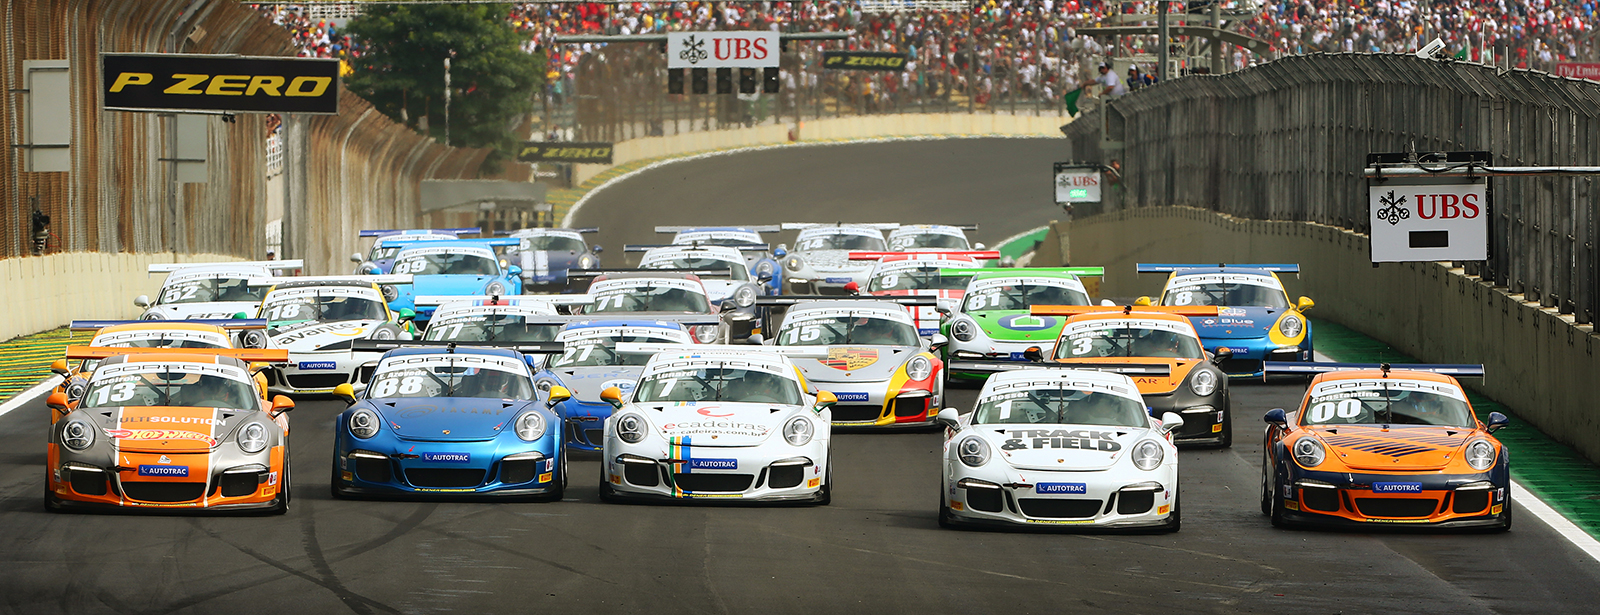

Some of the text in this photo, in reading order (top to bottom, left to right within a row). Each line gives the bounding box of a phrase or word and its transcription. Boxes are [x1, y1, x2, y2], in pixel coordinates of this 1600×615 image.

[713, 37, 768, 60] UBS
[1559, 65, 1600, 77] Fly Emir
[109, 71, 332, 98] P ZERO
[1072, 176, 1098, 187] UBS
[1415, 193, 1479, 221] UBS
[396, 260, 427, 275] 99
[595, 280, 695, 290] PORSCHE
[881, 275, 898, 289] 9
[976, 278, 1075, 288] PORSCHE
[1174, 276, 1274, 285] PORSCHE
[165, 286, 198, 303] 52
[273, 288, 374, 298] PORSCHE
[1174, 292, 1193, 306] 8
[596, 294, 624, 311] 71
[968, 293, 1001, 311] 81
[269, 304, 300, 321] 18
[792, 310, 903, 320] PORSCHE
[278, 321, 356, 345] avante
[563, 328, 681, 339] PORSCHE
[1072, 321, 1187, 332] PORSCHE
[99, 332, 219, 343] PORSCHE
[785, 325, 821, 344] 15
[1072, 338, 1093, 355] 3
[556, 344, 595, 367] 27
[388, 356, 518, 370] PORSCHE
[653, 361, 783, 374] PORSCHE
[103, 364, 239, 377] PORSCHE
[387, 370, 428, 379] Azevedo
[656, 370, 698, 379] Lunardi
[93, 383, 136, 405] 13
[374, 376, 424, 398] 88
[659, 378, 678, 398] 7
[993, 380, 1128, 394] PORSCHE
[1320, 381, 1454, 395] PORSCHE
[1312, 391, 1380, 404] Constantino
[994, 399, 1013, 420] 1
[1312, 399, 1362, 423] 00
[105, 415, 227, 427] MULTISOLUTION
[1005, 429, 1113, 440] TRACK
[1001, 437, 1121, 451] & FIELD
[149, 467, 186, 475] AUTOTRAC
[699, 460, 735, 468] AUTOTRAC
[1383, 484, 1420, 492] AUTOTRAC
